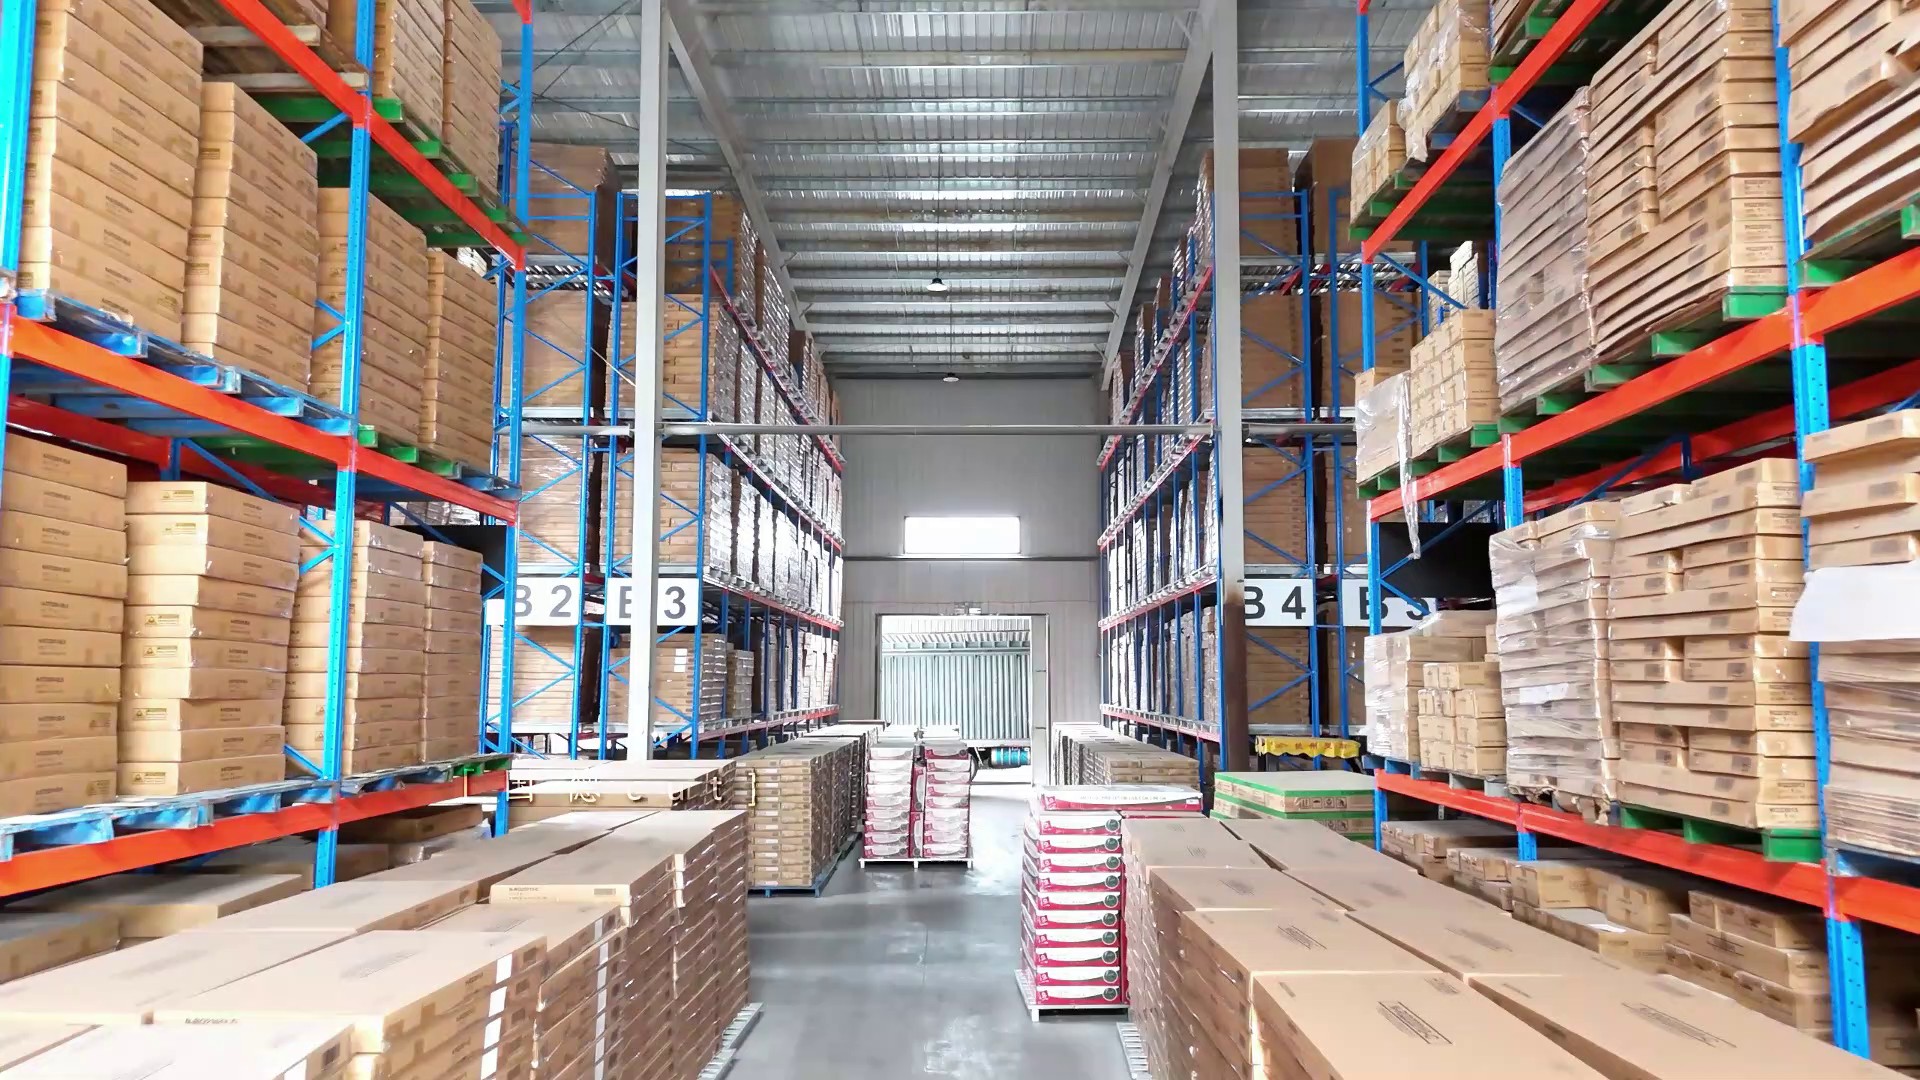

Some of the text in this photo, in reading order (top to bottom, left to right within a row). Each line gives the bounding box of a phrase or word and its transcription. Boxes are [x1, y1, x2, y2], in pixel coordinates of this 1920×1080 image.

[549, 584, 572, 618] 2
[663, 585, 687, 620] 3
[1244, 585, 1307, 620] B 4
